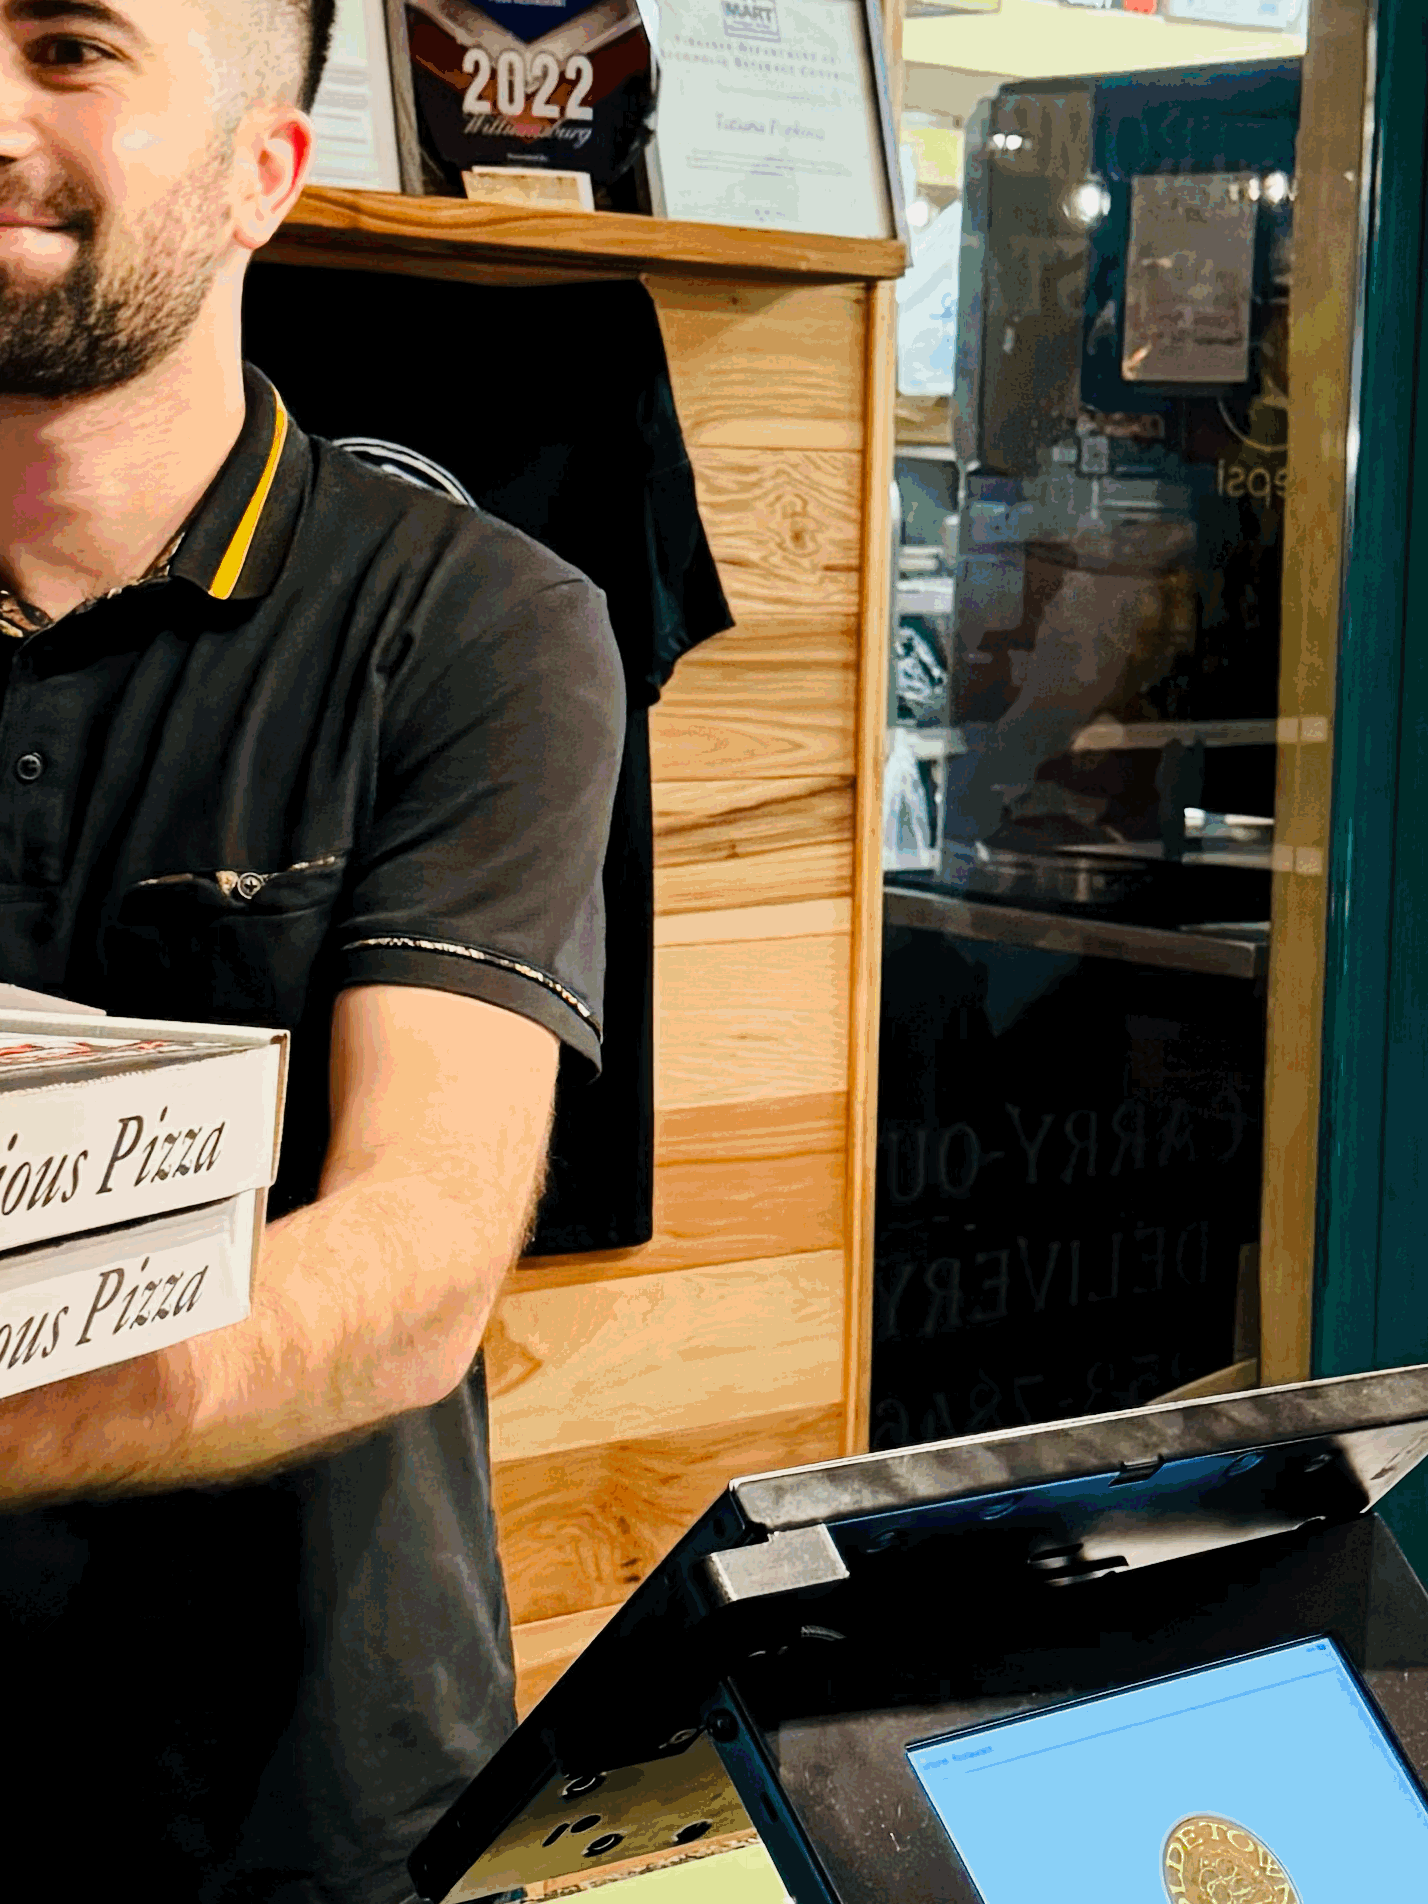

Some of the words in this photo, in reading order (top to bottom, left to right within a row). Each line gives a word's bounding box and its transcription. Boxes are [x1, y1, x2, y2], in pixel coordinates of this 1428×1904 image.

[461, 47, 594, 121] 2022
[97, 1105, 226, 1197] Pizza
[76, 1254, 206, 1347] Pizza
